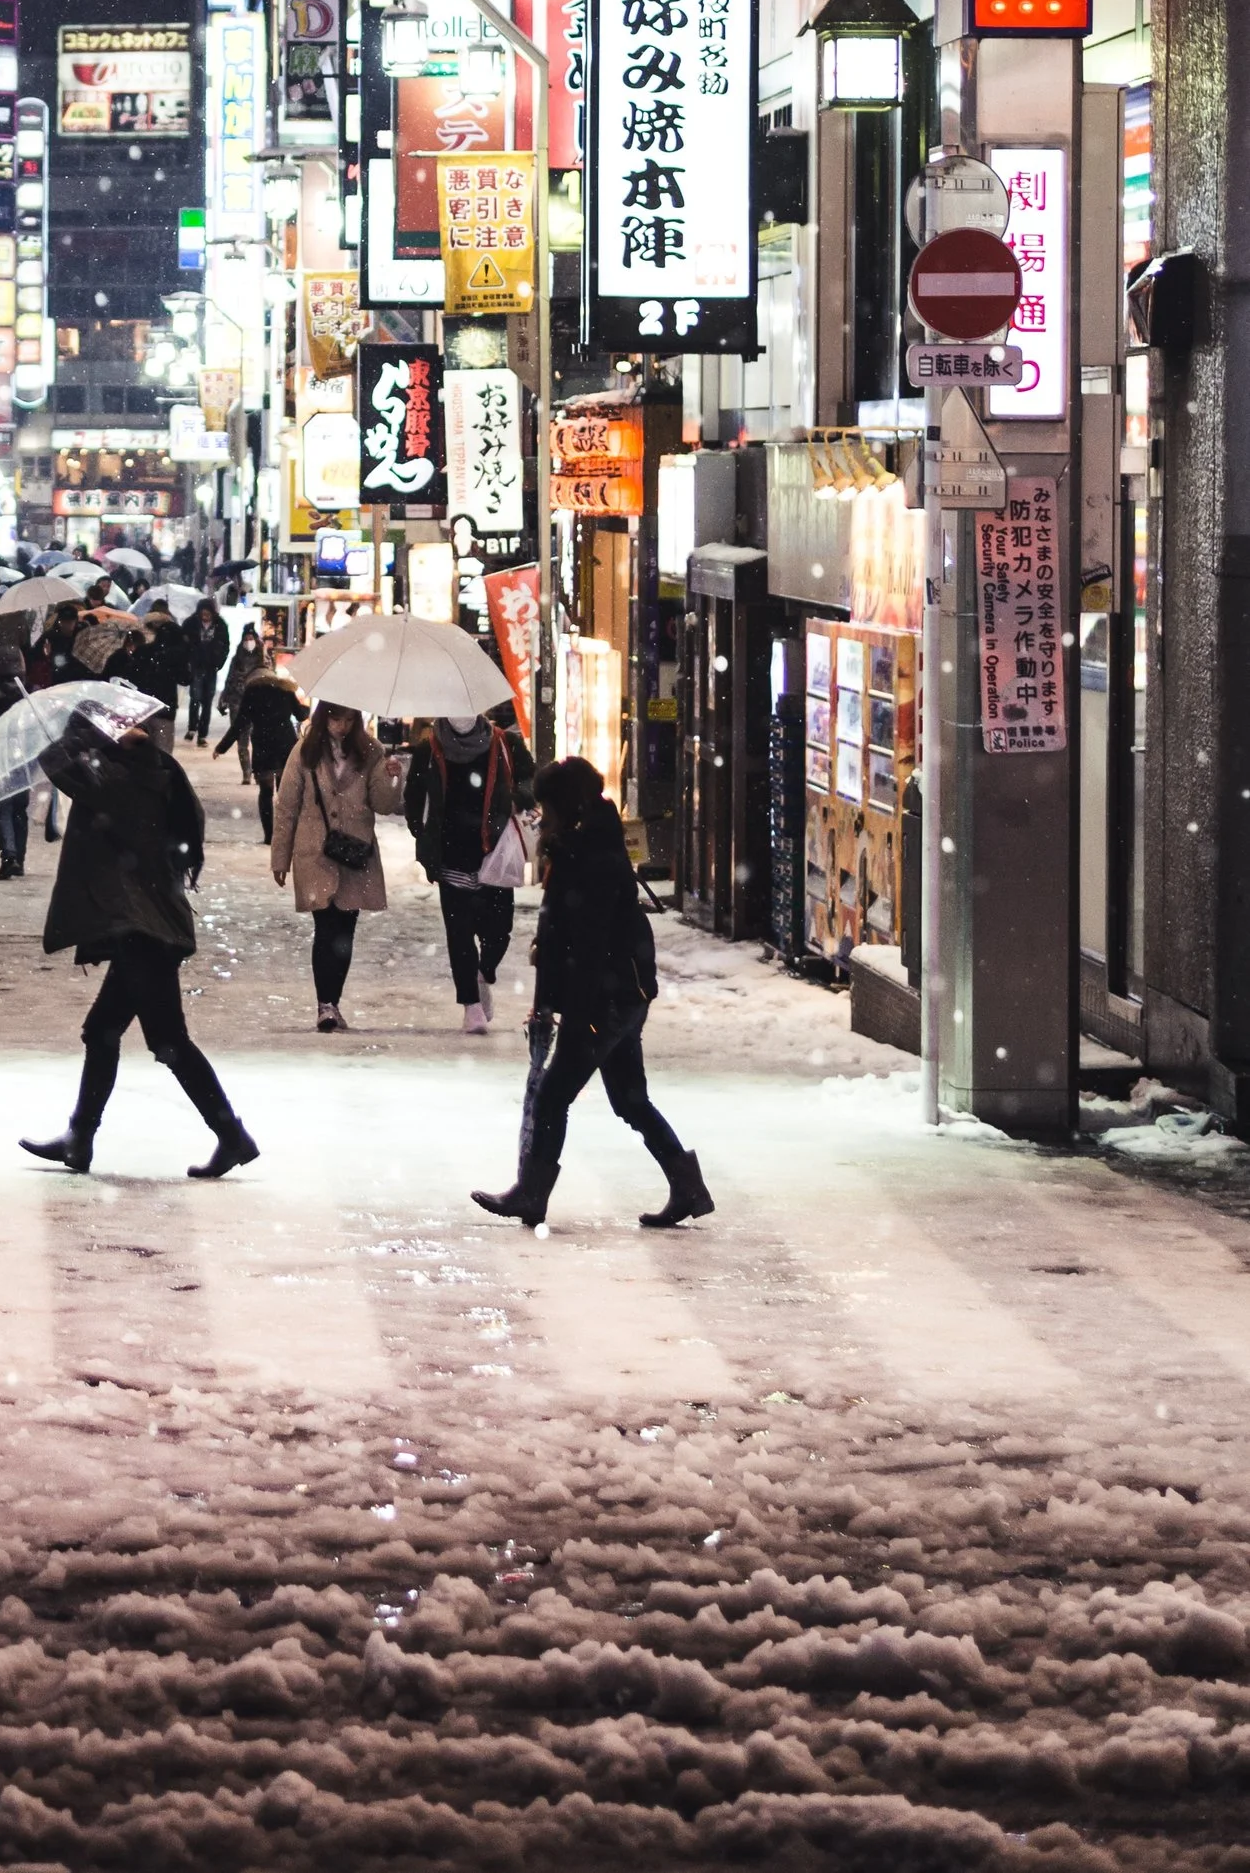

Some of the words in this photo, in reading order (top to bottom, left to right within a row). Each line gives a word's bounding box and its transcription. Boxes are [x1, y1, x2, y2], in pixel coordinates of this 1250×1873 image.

[446, 166, 526, 192] 悪質な
[446, 197, 525, 221] 客引き
[449, 225, 526, 250] に注意
[637, 298, 699, 336] 2F
[917, 353, 1015, 378] 自転車を除く
[486, 537, 522, 554] B1F
[980, 522, 995, 580] Security
[995, 526, 1008, 557] Your
[996, 560, 1010, 604] Safety
[982, 582, 997, 636] Camera
[1009, 499, 1038, 706] 防犯カメラ作動中
[1033, 486, 1058, 717] みなさまの安全を守ります
[985, 639, 996, 650] in
[985, 655, 1000, 719] Operation
[1009, 736, 1047, 750] Police
